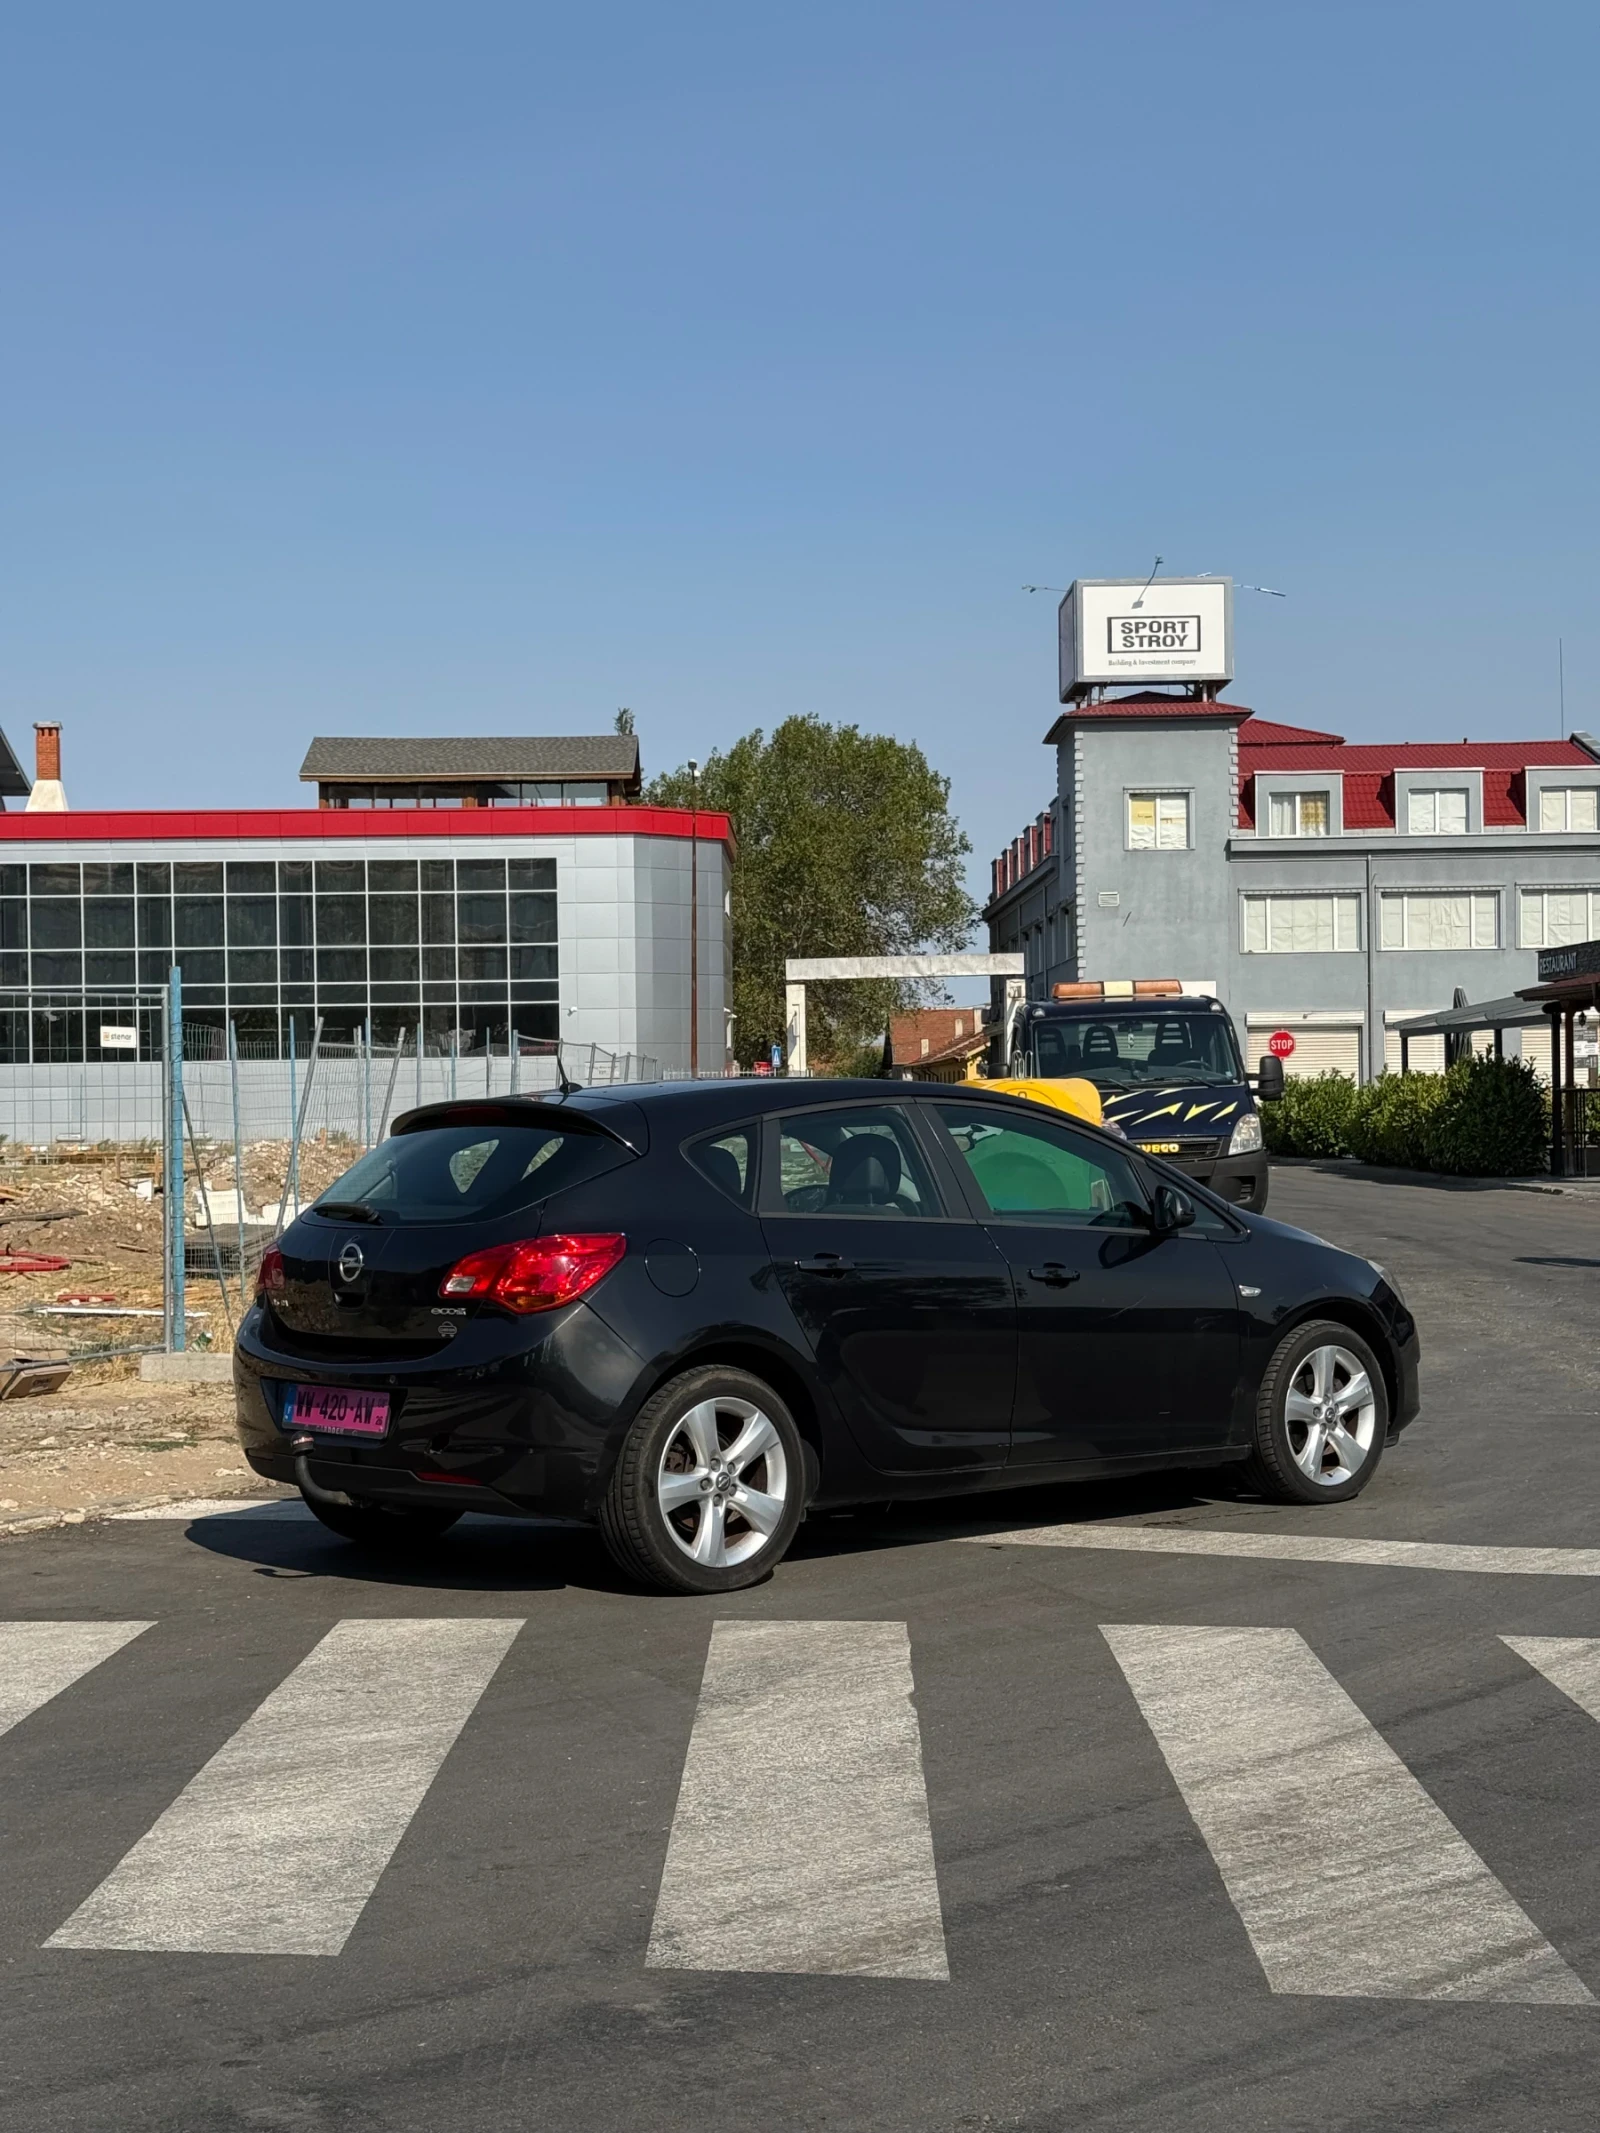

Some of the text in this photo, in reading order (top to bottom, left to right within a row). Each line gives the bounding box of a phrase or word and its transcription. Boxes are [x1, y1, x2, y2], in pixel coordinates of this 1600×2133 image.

[1121, 621, 1190, 634] SPORT
[1122, 635, 1189, 648] STROY
[1540, 952, 1577, 974] RESTAURANT
[1271, 1040, 1293, 1050] STOP
